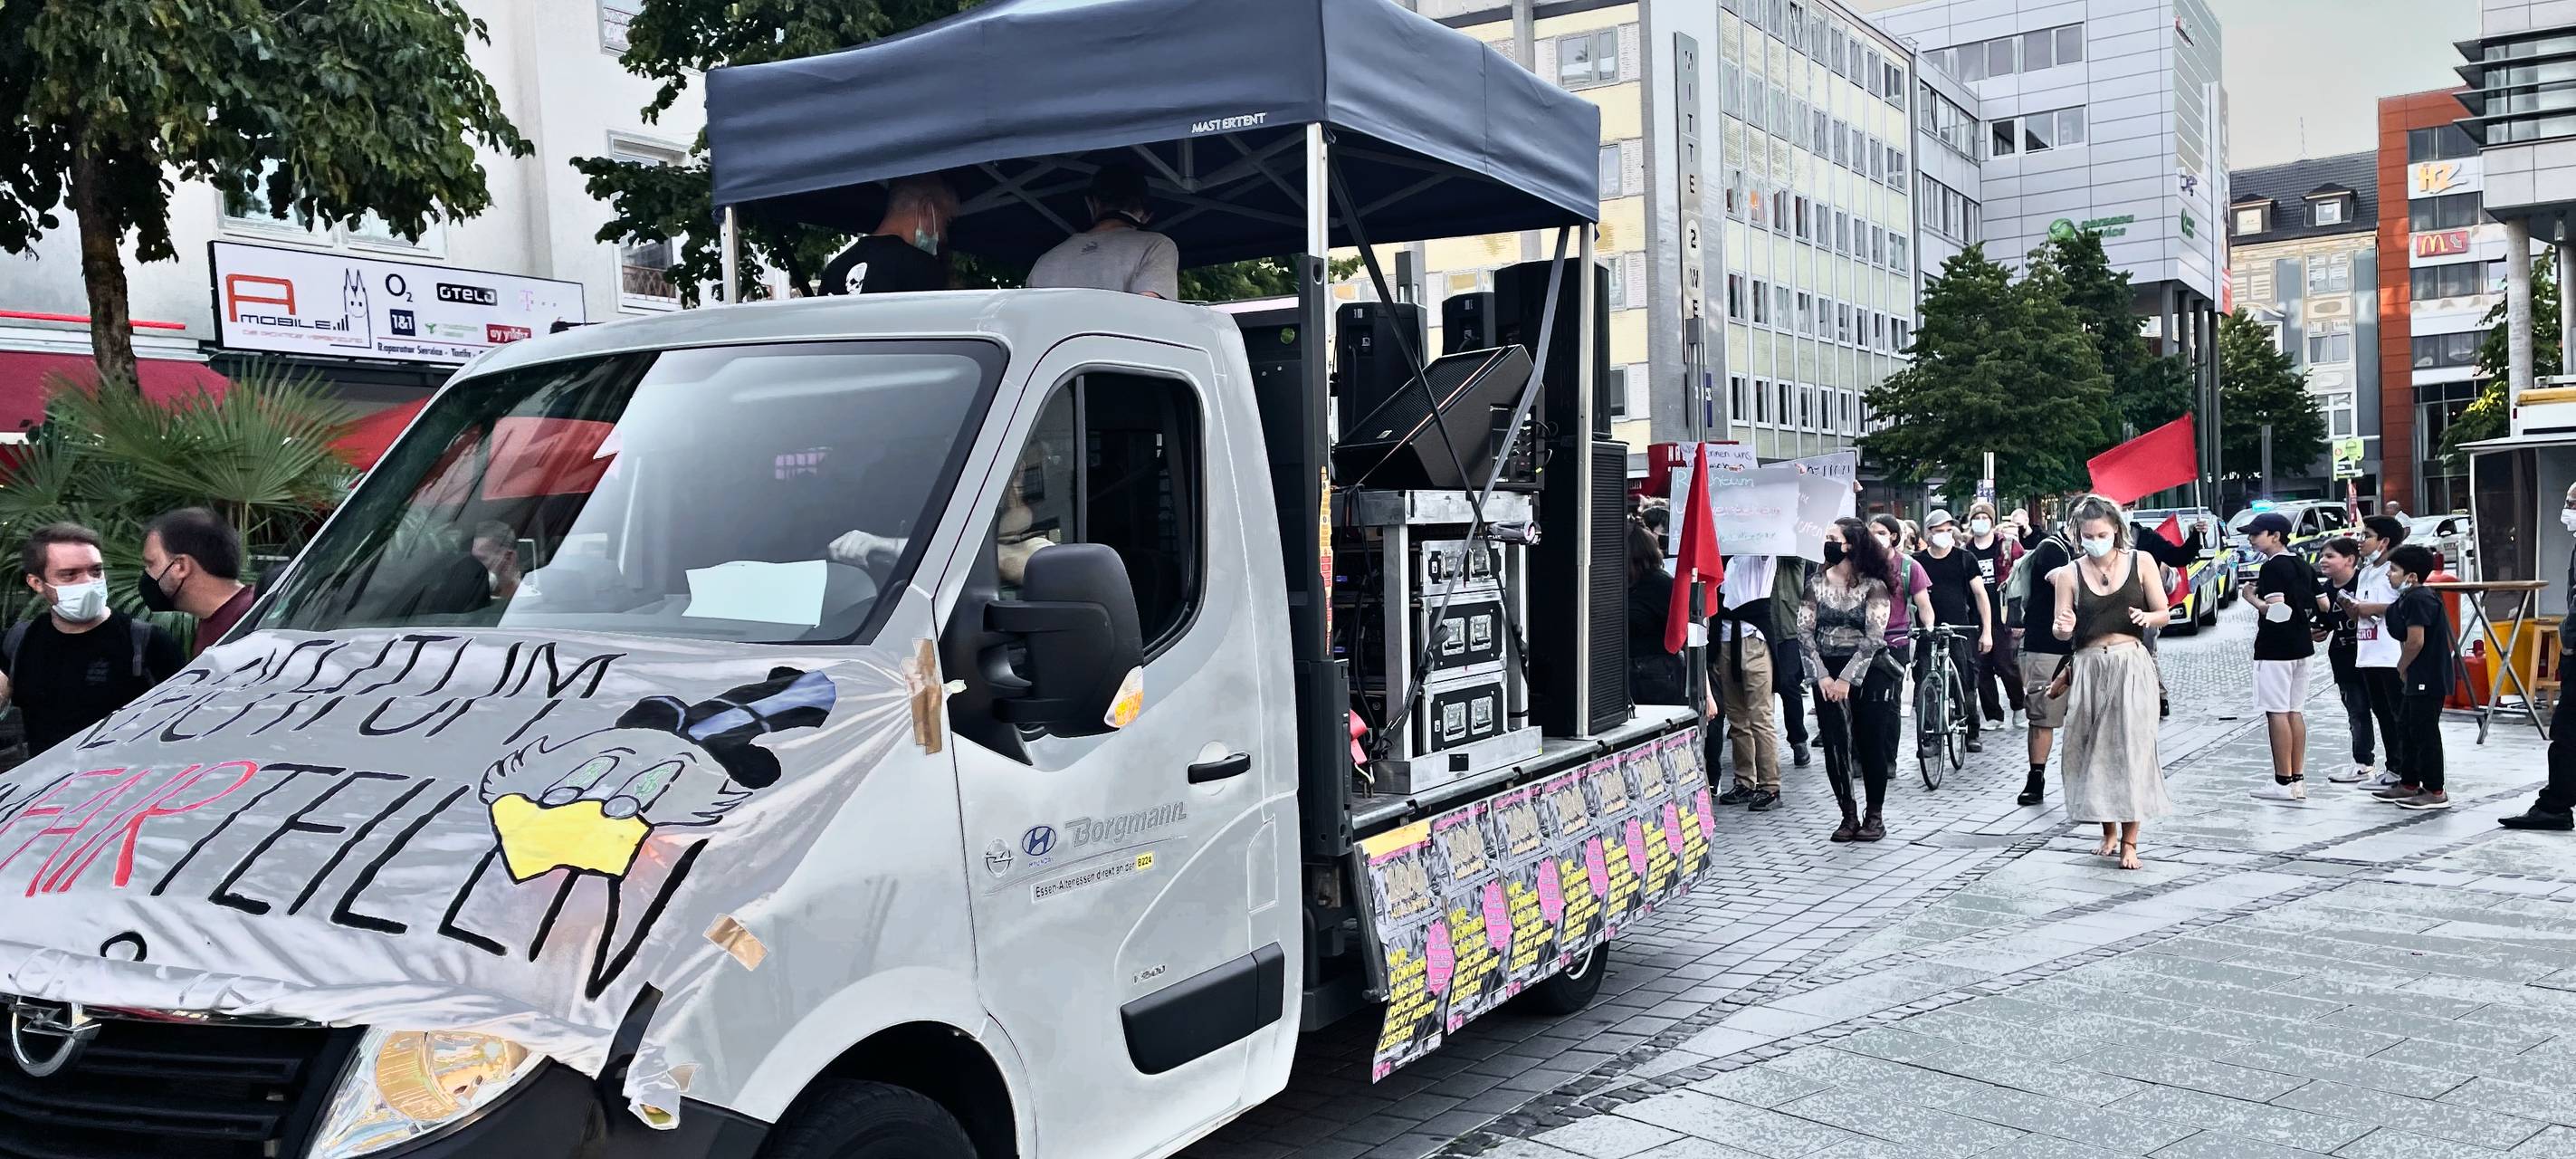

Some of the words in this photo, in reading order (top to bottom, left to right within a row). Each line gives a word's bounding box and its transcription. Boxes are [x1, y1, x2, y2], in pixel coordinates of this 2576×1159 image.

[1191, 112, 1266, 133] MASTERTENT
[391, 314, 413, 330] 1&1
[1383, 1011, 1412, 1036] NICHT
[1411, 999, 1436, 1021] MEHR
[1388, 990, 1425, 1019] REICHEN
[1378, 1023, 1416, 1052] LEISTEN
